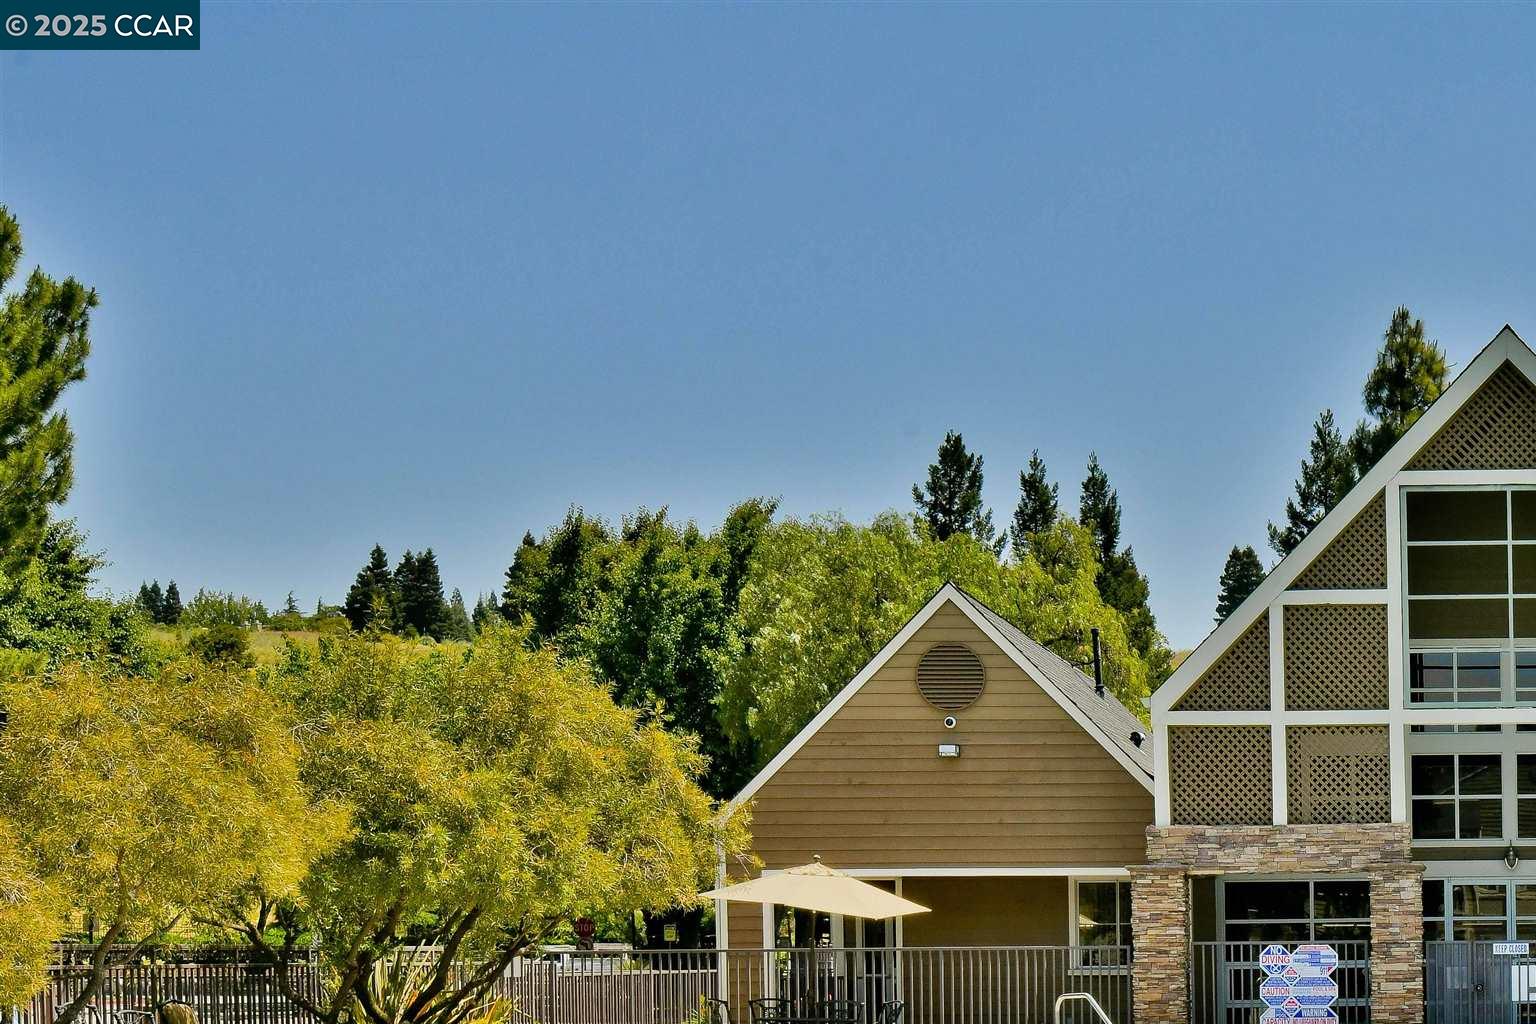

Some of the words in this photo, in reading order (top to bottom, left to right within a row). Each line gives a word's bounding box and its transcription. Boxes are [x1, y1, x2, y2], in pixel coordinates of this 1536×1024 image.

[1270, 946, 1282, 955] NO
[1495, 944, 1507, 953] KEEP
[1508, 944, 1528, 953] CLOSED
[1262, 955, 1290, 964] DIVING
[1262, 987, 1290, 996] CAUTION
[1301, 1008, 1328, 1017] WARNING
